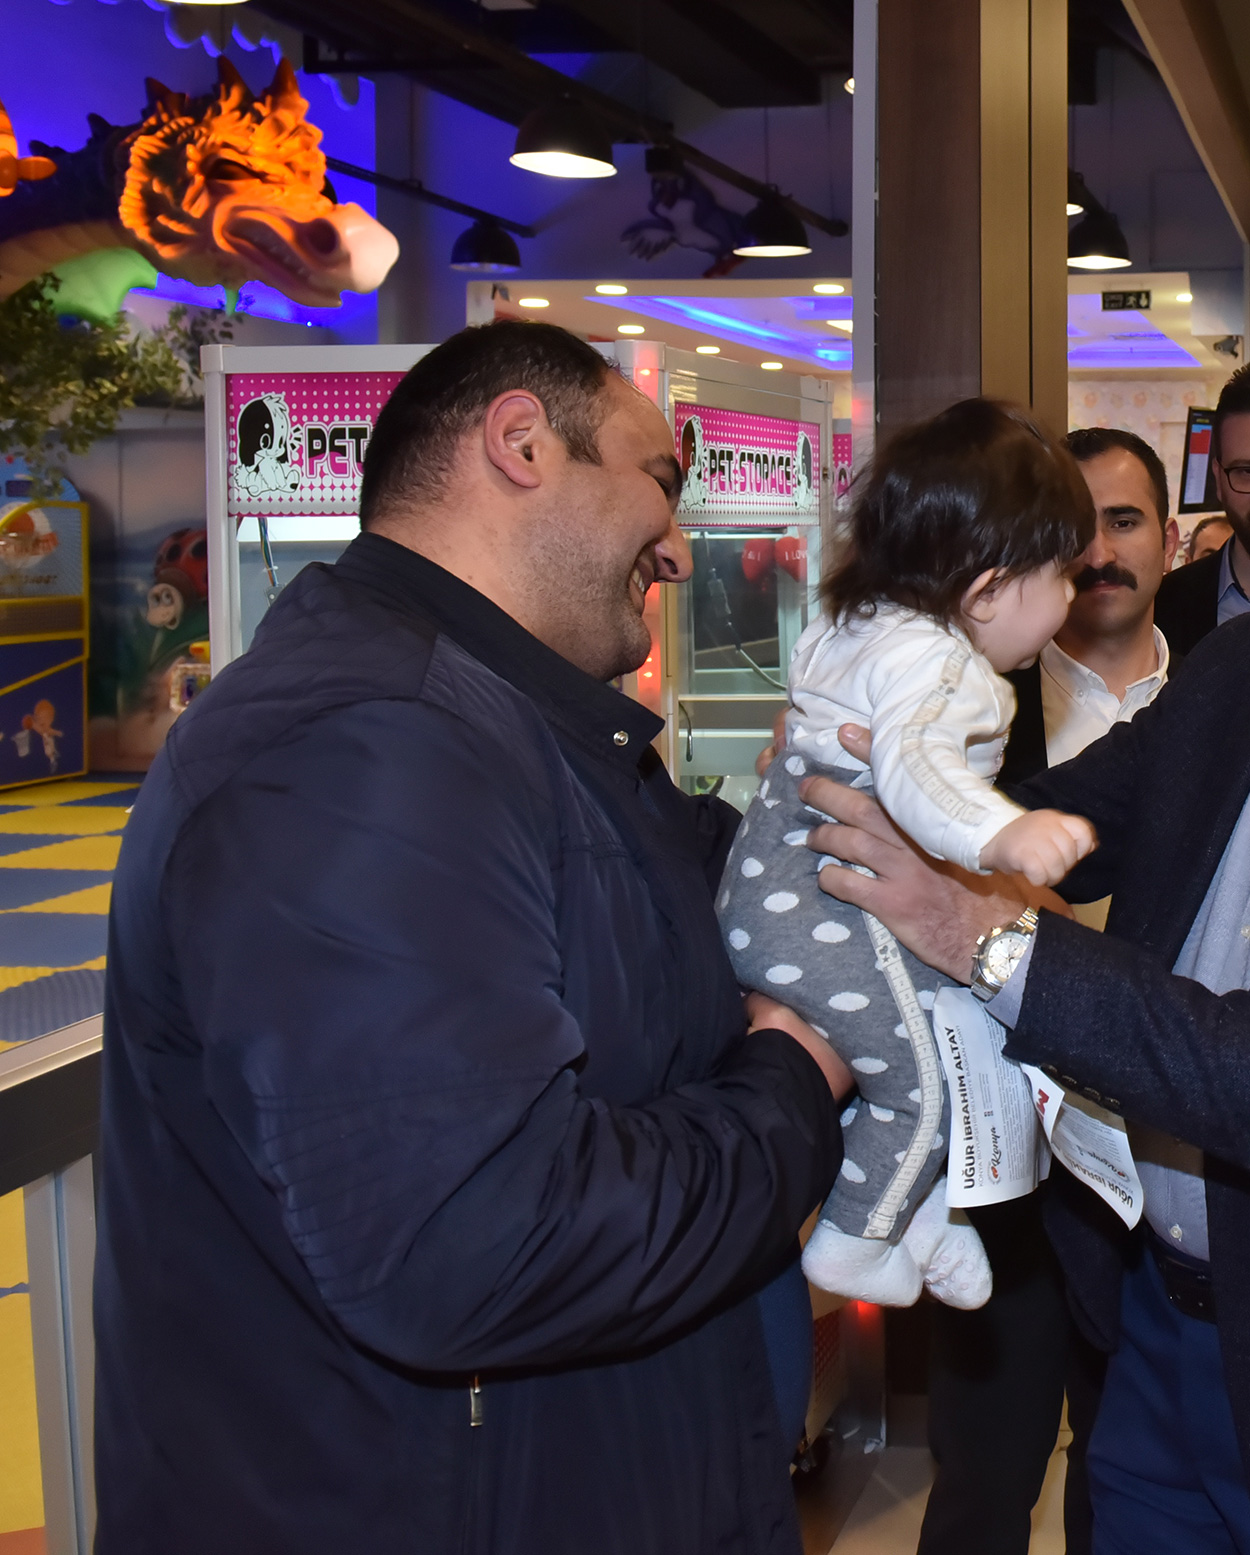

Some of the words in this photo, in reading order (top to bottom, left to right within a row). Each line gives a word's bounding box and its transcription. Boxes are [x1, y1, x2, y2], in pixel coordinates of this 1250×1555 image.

[305, 424, 371, 477] PET
[708, 446, 735, 496] PET
[738, 449, 794, 498] STORAGE
[944, 1026, 964, 1071] ALTAY
[955, 1025, 965, 1046] ADAYI
[961, 1047, 971, 1077] BAŞKAN
[957, 1075, 973, 1141] İBRAHİM
[966, 1077, 976, 1113] BELEDİYE
[961, 1145, 975, 1189] UĞUR
[990, 1126, 1002, 1167] Konya
[976, 1161, 984, 1187] KONYA
[1107, 1181, 1134, 1209] UĞUR
